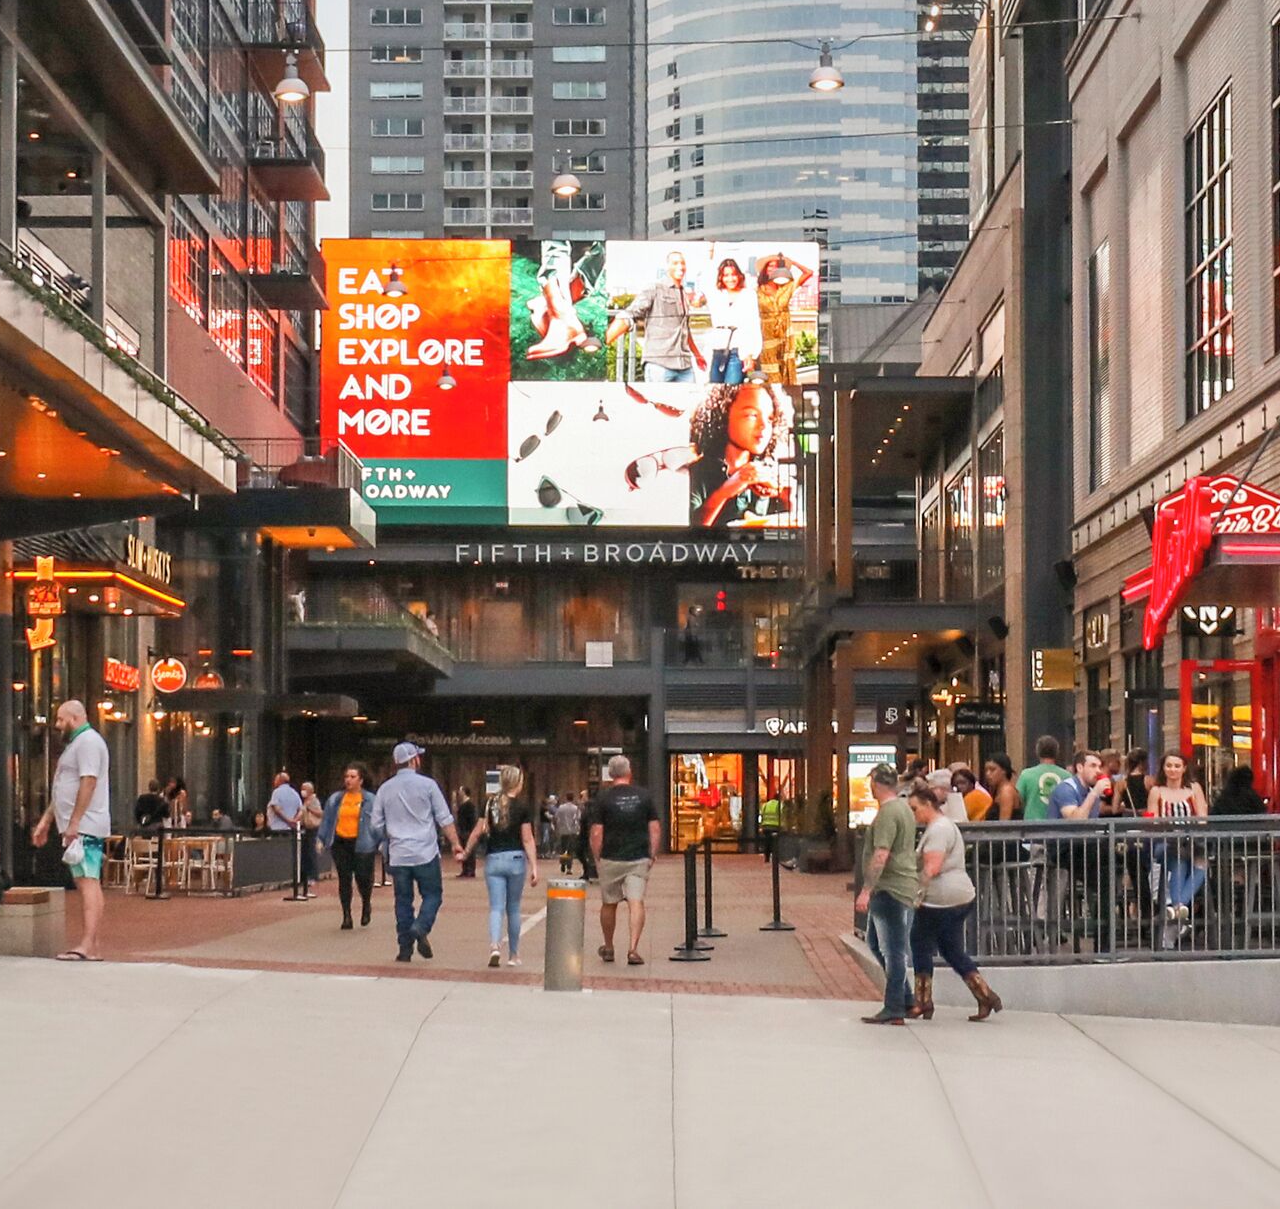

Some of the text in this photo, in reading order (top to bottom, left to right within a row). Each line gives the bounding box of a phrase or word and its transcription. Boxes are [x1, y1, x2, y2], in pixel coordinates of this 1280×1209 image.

[338, 373, 412, 401] AND
[361, 467, 402, 481] FTH
[365, 484, 451, 499] OADWAY
[1035, 650, 1043, 688] REVV
